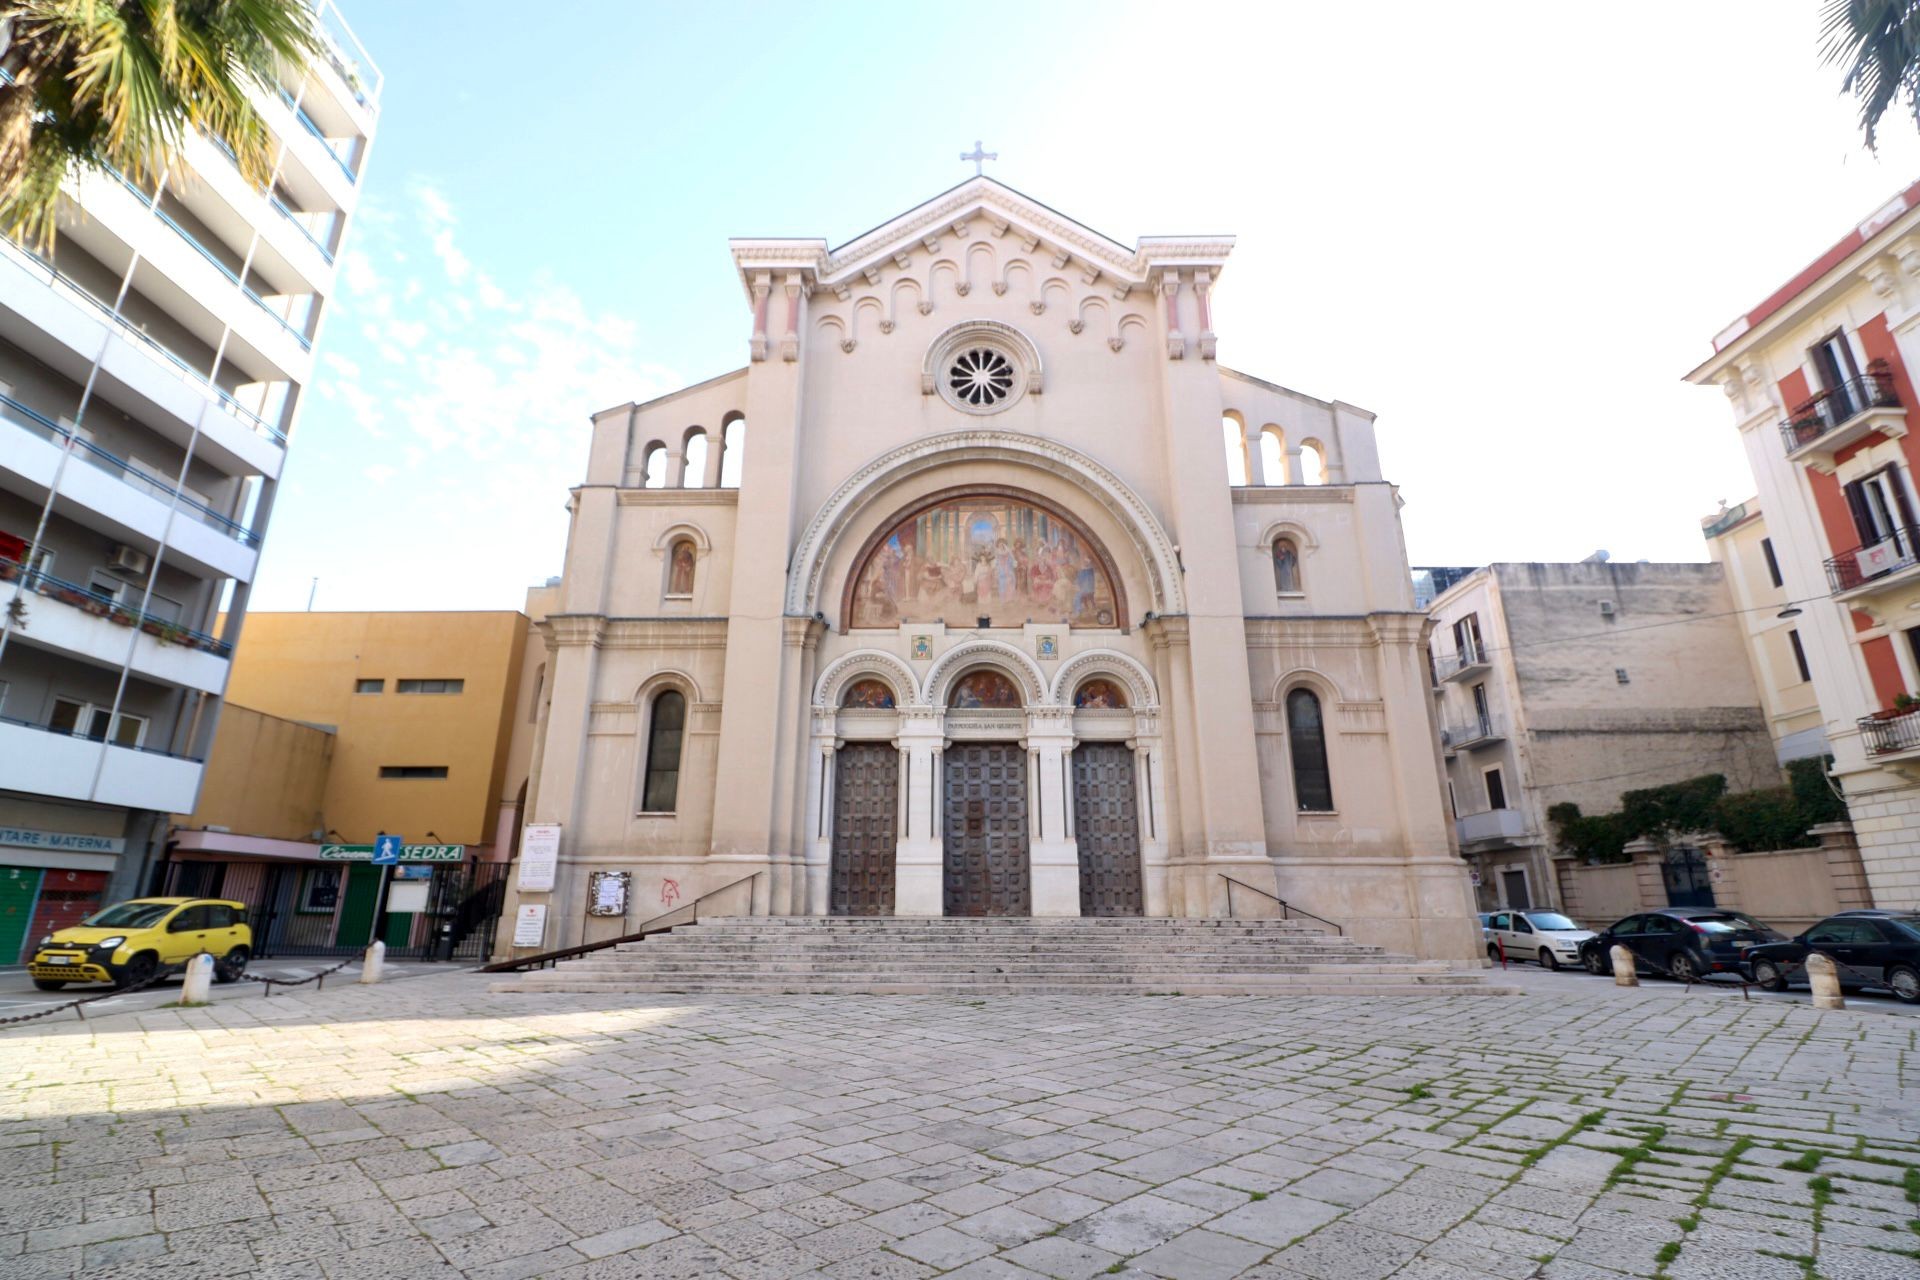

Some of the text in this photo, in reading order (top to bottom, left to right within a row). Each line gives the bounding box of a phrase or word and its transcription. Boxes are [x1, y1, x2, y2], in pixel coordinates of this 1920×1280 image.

[48, 834, 112, 849] MATERNA
[321, 846, 460, 859] Cinem SEDRA
